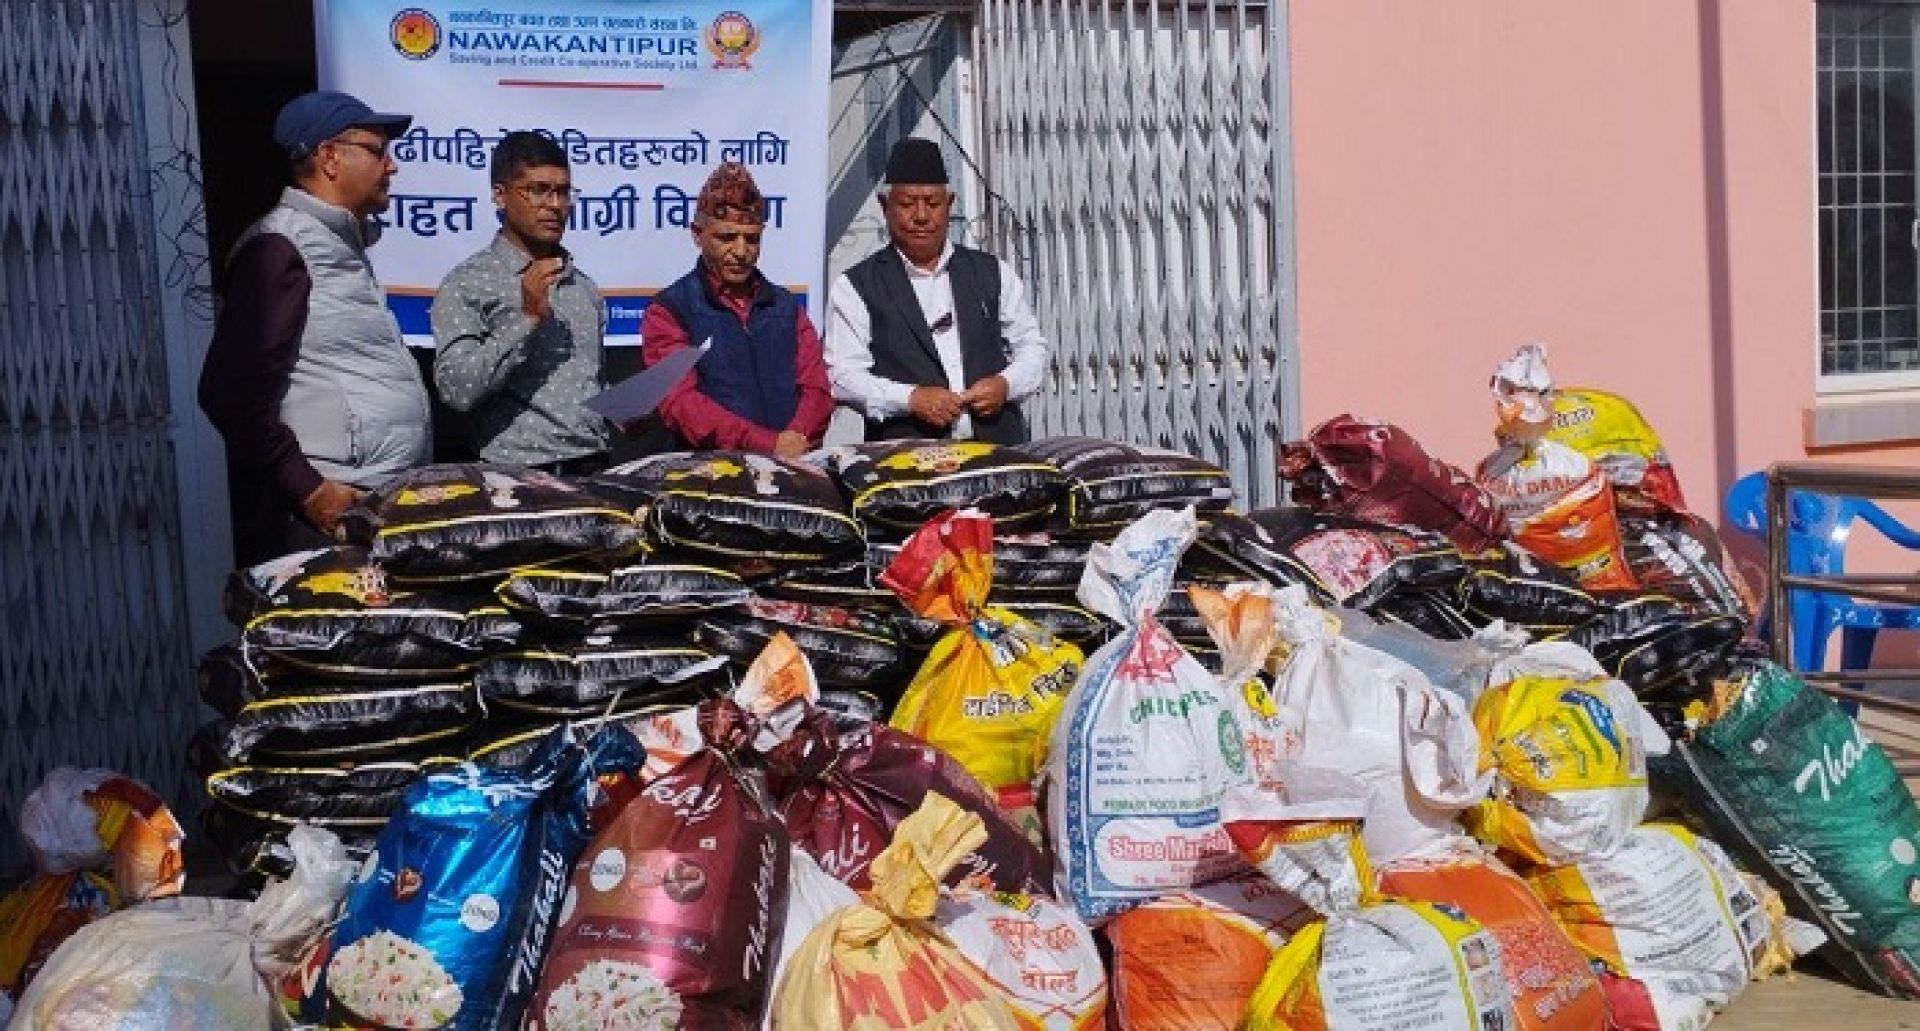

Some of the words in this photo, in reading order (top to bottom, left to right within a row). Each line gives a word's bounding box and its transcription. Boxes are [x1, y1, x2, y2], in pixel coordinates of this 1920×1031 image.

[448, 31, 698, 56] NAWAKANTIPUR
[493, 55, 517, 66] and
[719, 131, 790, 165] लागि
[1109, 835, 1166, 861] Shree
